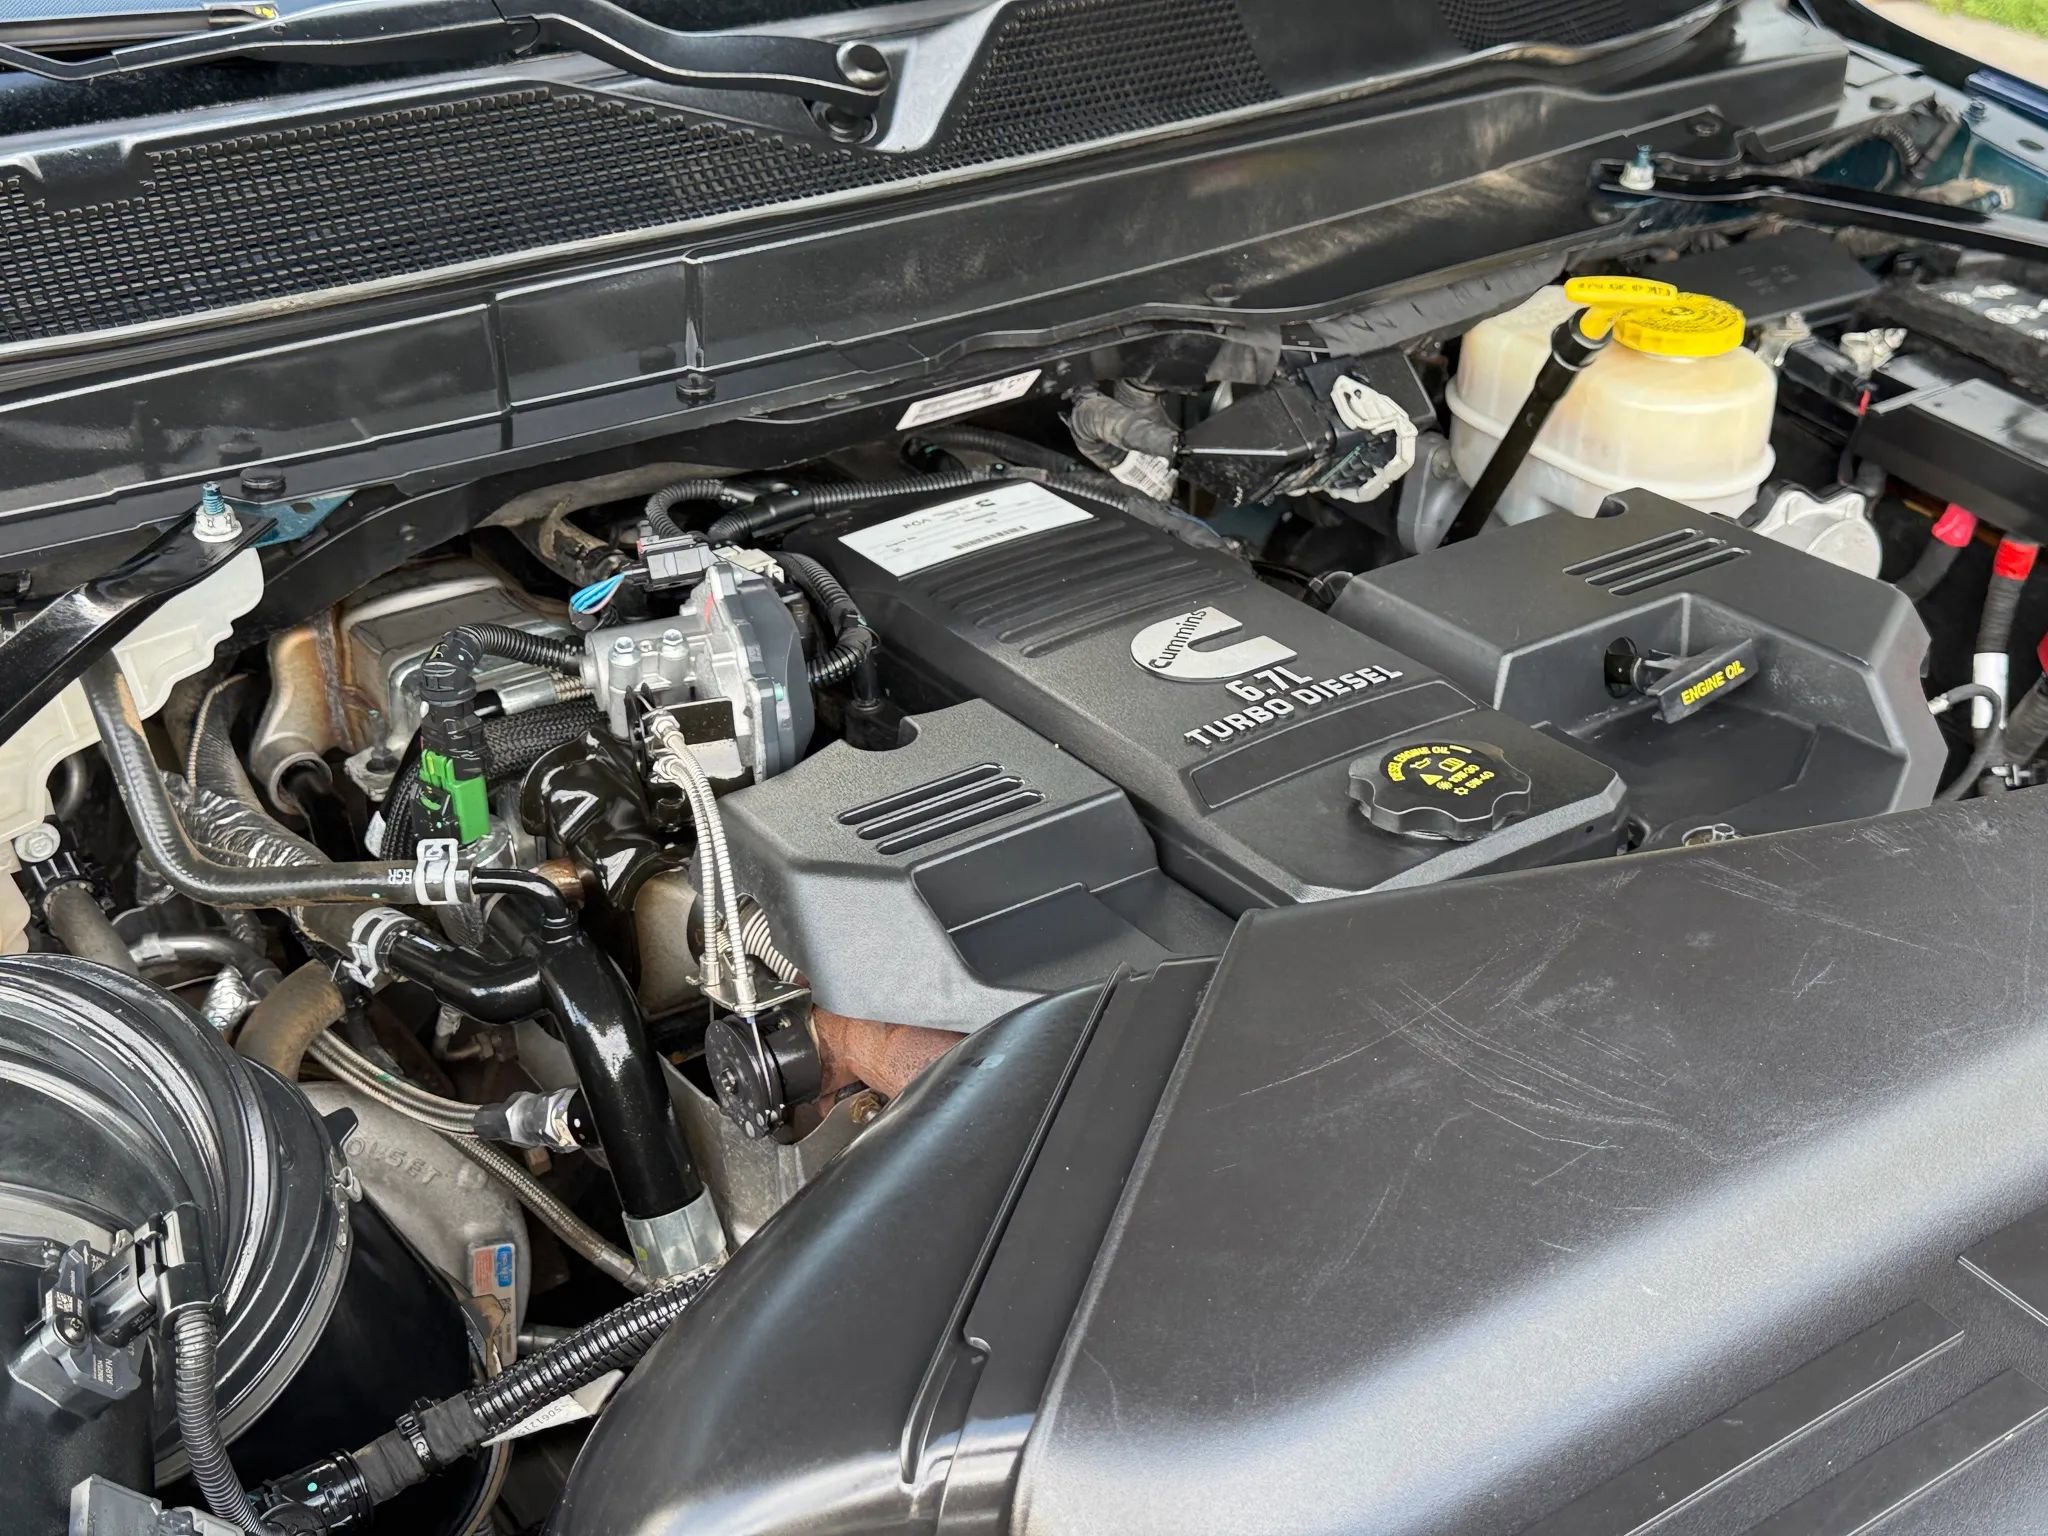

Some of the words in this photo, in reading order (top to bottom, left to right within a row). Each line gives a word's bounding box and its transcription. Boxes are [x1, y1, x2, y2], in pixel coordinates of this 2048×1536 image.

[1224, 665, 1313, 703] 6.7L
[1680, 671, 1726, 706] ENGINE
[1724, 660, 1746, 681] OIL
[1183, 698, 1295, 747] TURBO
[1290, 664, 1404, 706] DIESEL
[1431, 745, 1451, 755] OIL
[388, 868, 413, 885] EGR
